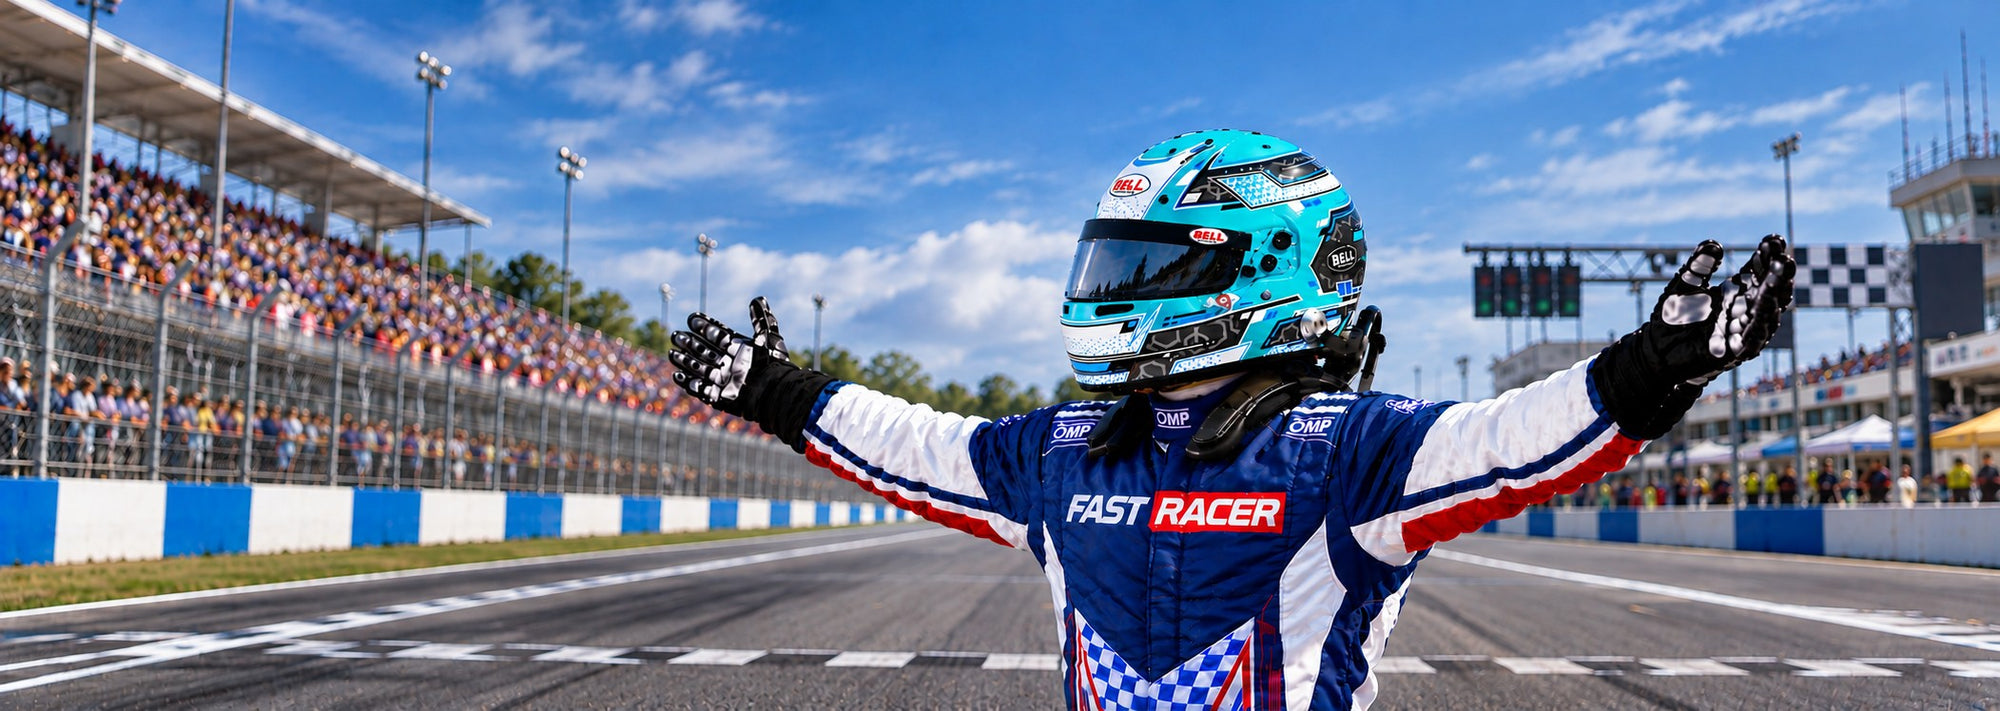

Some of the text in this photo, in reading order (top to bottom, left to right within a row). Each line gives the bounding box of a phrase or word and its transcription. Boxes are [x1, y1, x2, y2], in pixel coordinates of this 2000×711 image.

[1193, 230, 1225, 242] BELL
[1331, 250, 1355, 267] BELL
[1156, 411, 1190, 426] OMP
[1053, 425, 1092, 439] OMP
[1289, 419, 1333, 434] OMP
[1066, 494, 1281, 527] FAST RACER
